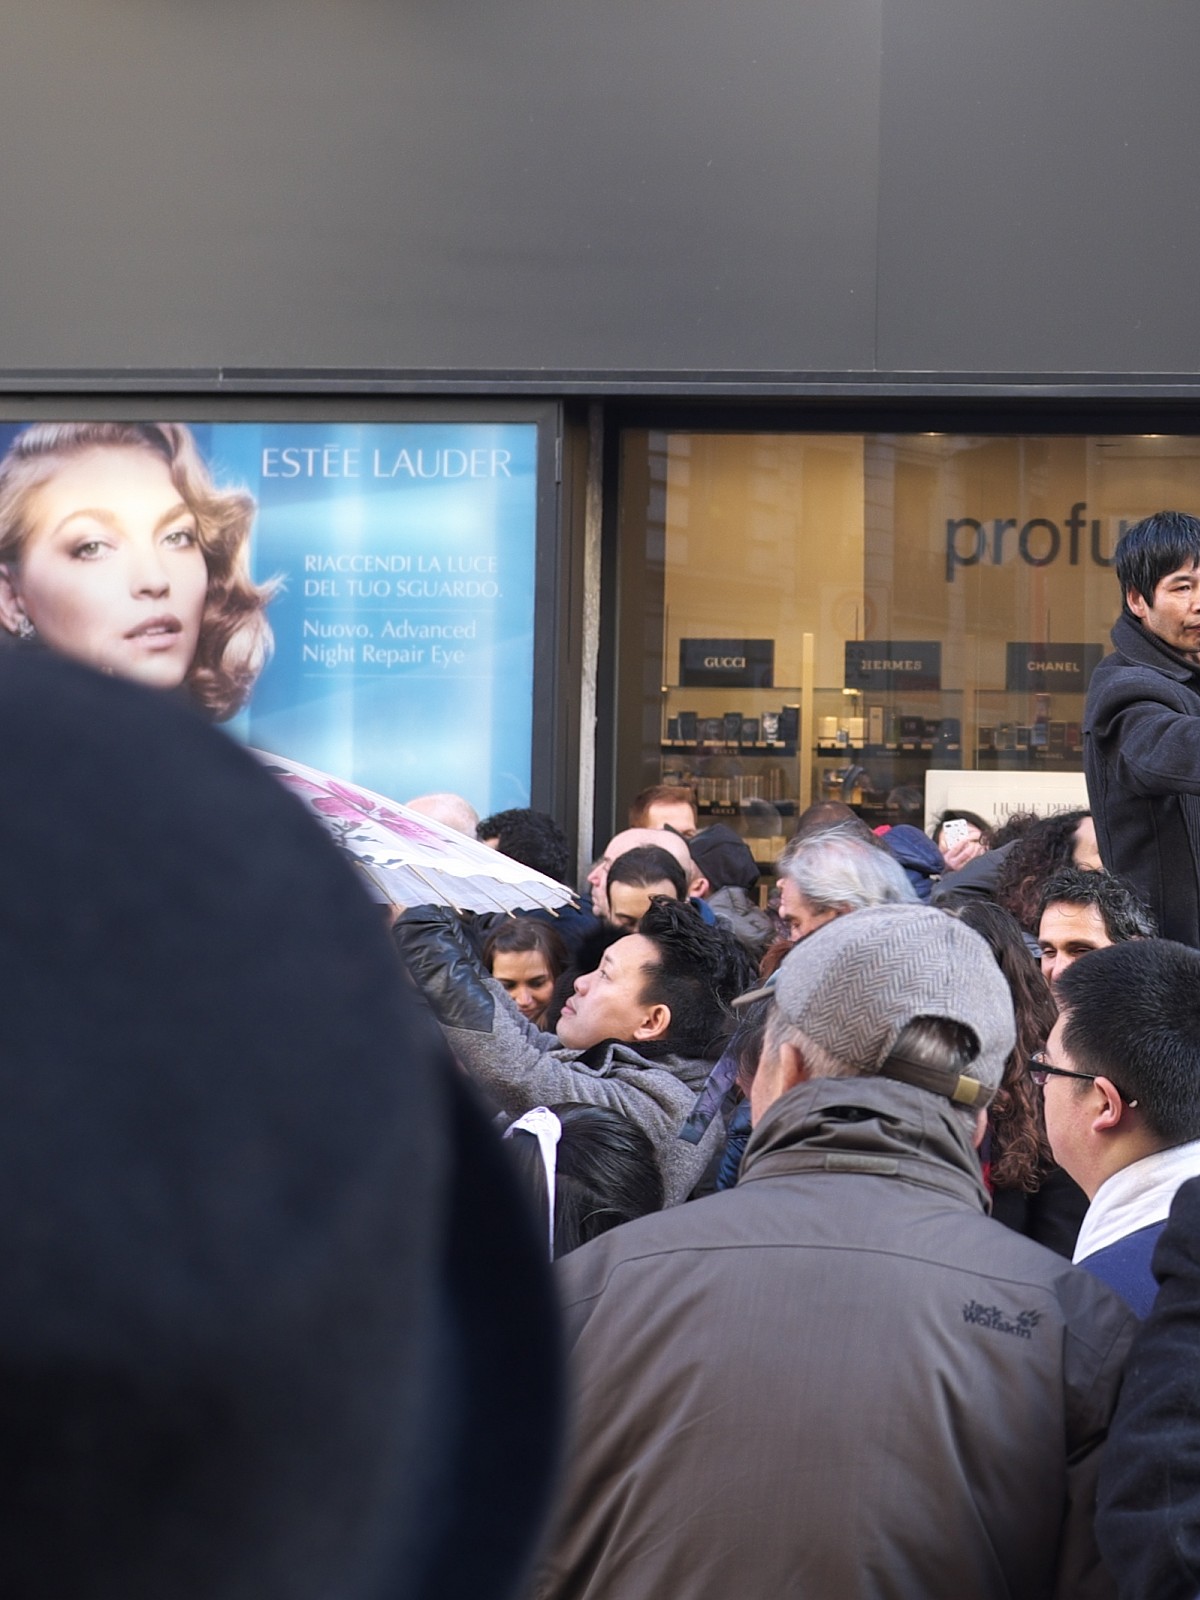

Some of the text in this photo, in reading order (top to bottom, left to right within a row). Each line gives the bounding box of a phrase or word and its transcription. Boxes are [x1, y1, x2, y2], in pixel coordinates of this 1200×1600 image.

[373, 448, 512, 478] LAUDER
[304, 555, 498, 574] RIACCENDI LA LUCE
[304, 579, 503, 599] DEL TUO SGUARDO.
[303, 618, 477, 640] Nuovo. Advanced
[303, 642, 465, 669] Night Repair Eye
[704, 656, 747, 669] GUCCI
[861, 659, 923, 671] HERMES
[1026, 660, 1081, 673] CHANEL
[964, 1299, 1003, 1319] Jack
[962, 1307, 1032, 1340] Wolfskin
